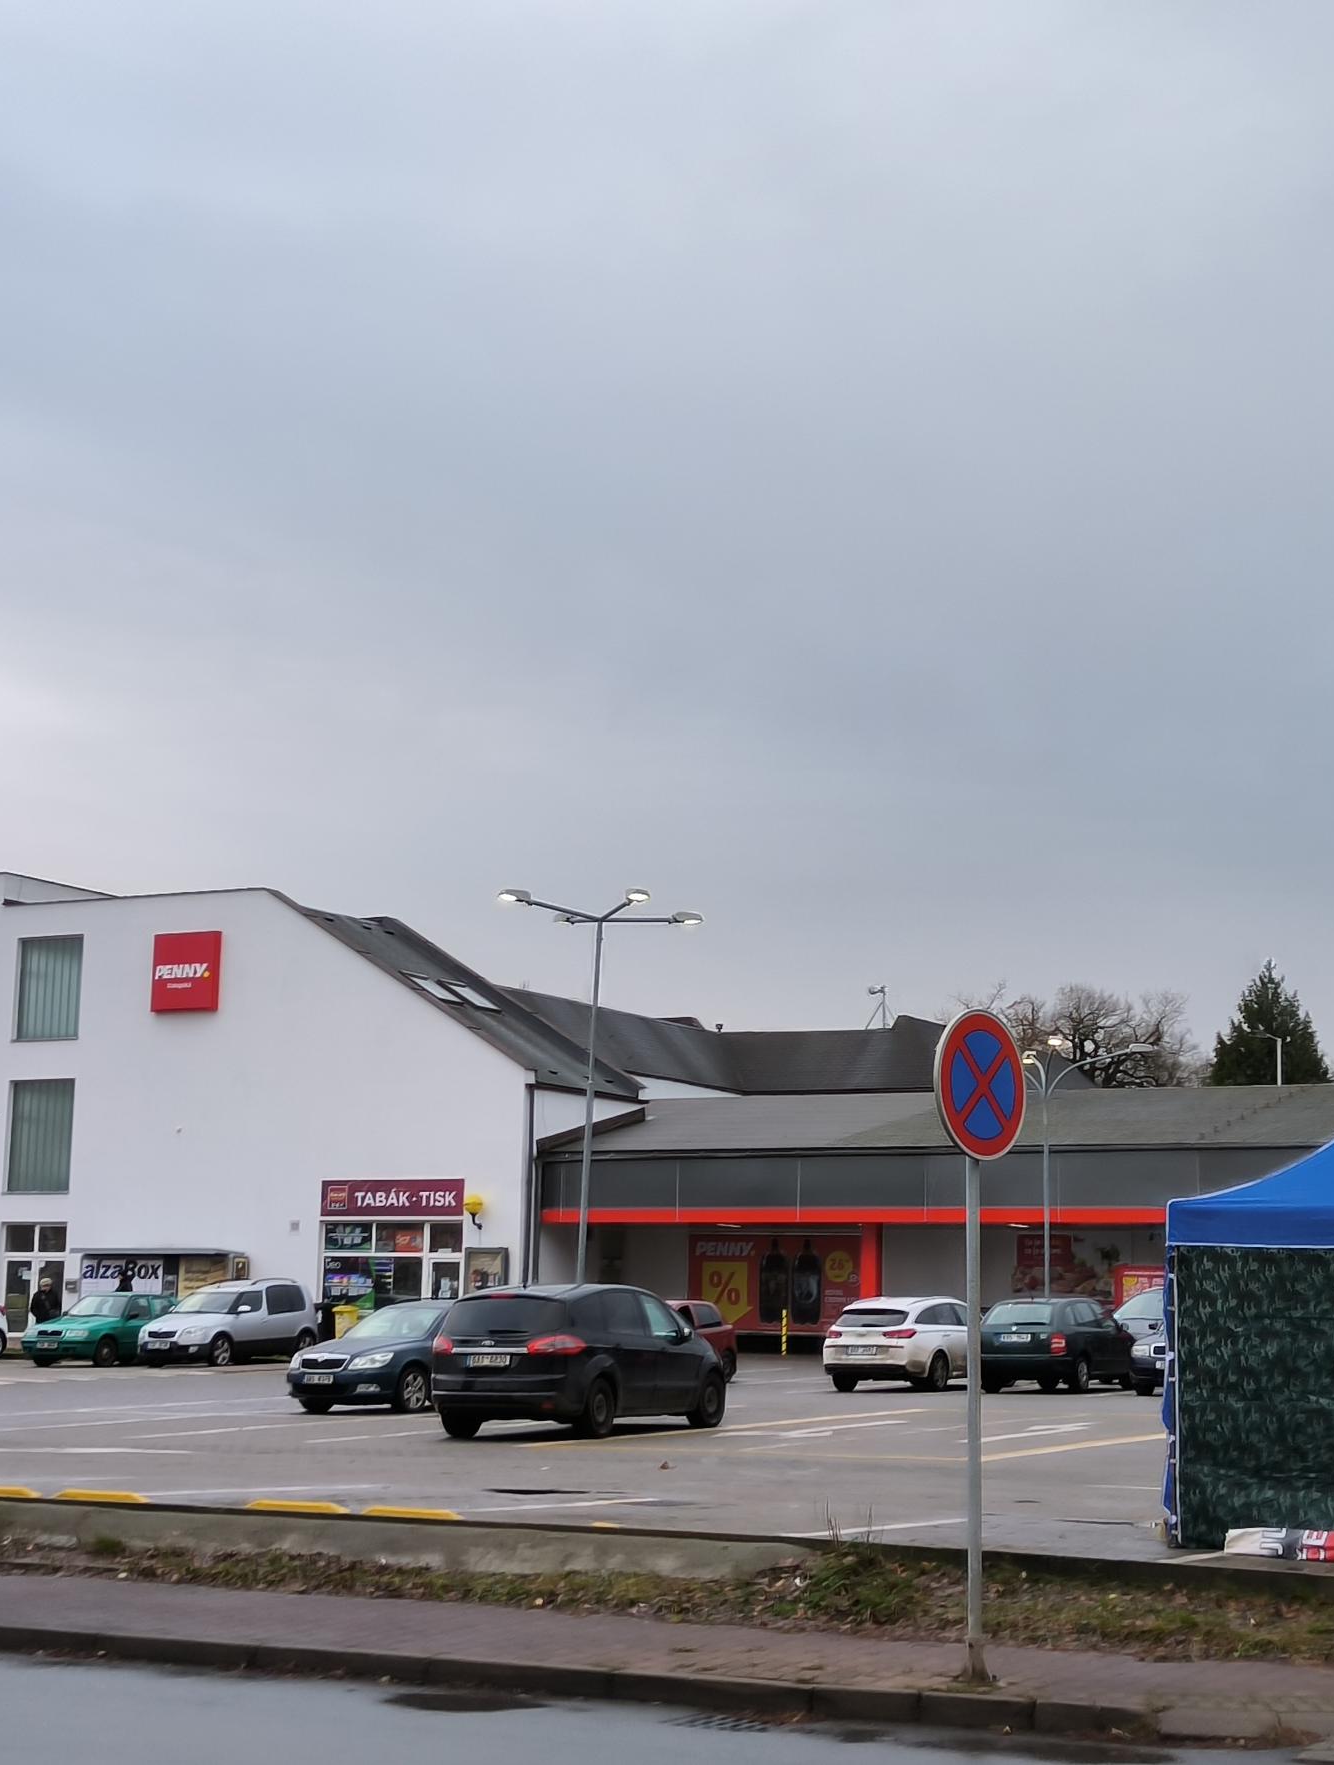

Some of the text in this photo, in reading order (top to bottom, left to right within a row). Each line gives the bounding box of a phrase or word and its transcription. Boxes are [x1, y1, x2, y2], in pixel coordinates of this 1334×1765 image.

[354, 1188, 410, 1207] TABÁK
[419, 1191, 457, 1207] TISK
[695, 1241, 755, 1257] PENNY.
